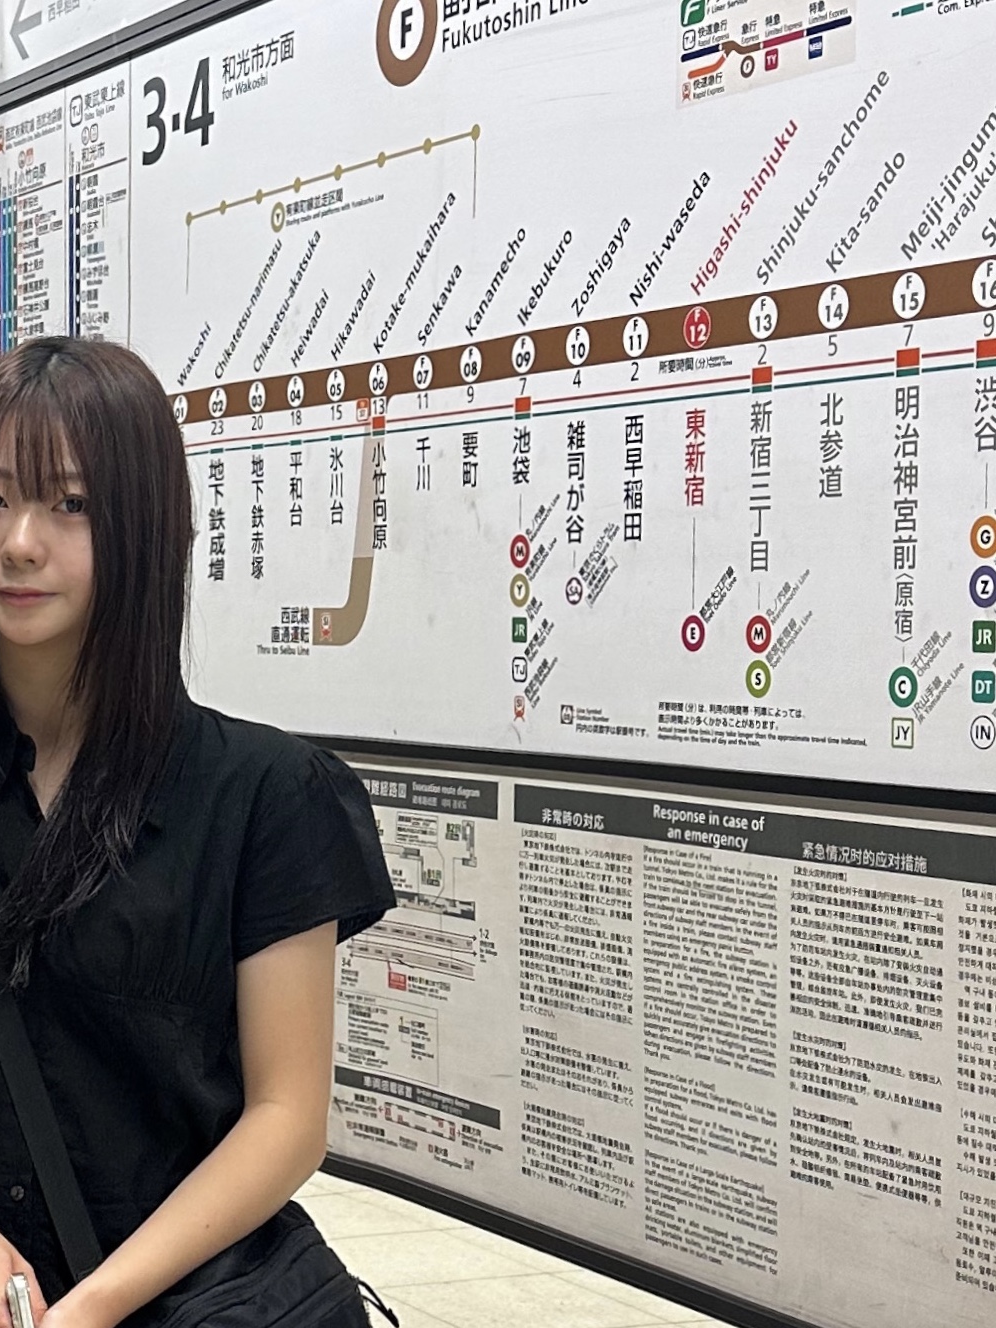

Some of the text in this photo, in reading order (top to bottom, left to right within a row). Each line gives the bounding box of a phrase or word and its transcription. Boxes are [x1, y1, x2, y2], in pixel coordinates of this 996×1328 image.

[937, 3, 961, 15] Com.
[400, 7, 414, 49] F
[441, 0, 542, 53] Fukutoshin
[741, 20, 758, 36] 急行
[221, 30, 295, 85] 和光市方面
[766, 54, 777, 66] TY
[221, 71, 269, 101] for Wakoshi
[756, 70, 890, 286] Shinjuku-sanchome
[689, 118, 799, 297] Higashi-shinjuku
[824, 151, 906, 275] Kita-sando
[628, 171, 711, 308] Nishi-waseda
[372, 191, 456, 355] Kotake-mukaihara
[570, 216, 632, 319] Zoshigaya
[986, 262, 994, 277] F
[464, 227, 526, 338] Kanamecho
[516, 229, 573, 328] Ikebukuro
[905, 275, 912, 290] F
[253, 230, 322, 374] Chikatetsu-akatsuka
[830, 287, 837, 301] F
[900, 292, 920, 312] 15
[214, 238, 283, 380] Chikatetsu-narimasu
[416, 264, 463, 348] Senkawa
[760, 299, 767, 311] F
[825, 303, 843, 321] 14
[330, 269, 377, 363] Hikawadai
[694, 309, 701, 322] F
[755, 315, 772, 333] 13
[290, 288, 330, 368] Heiwadai
[633, 320, 639, 332] F
[689, 326, 706, 342] 12
[983, 313, 995, 337] 9
[520, 338, 526, 349] F
[575, 329, 580, 341] F
[629, 334, 643, 350] 11
[902, 324, 914, 347] 7
[176, 321, 212, 387] Wakoshi
[468, 348, 473, 359] F
[571, 343, 586, 359] 10
[828, 334, 838, 357] 5
[420, 358, 425, 368] F
[515, 352, 531, 368] 09
[757, 344, 767, 366] 2
[376, 365, 380, 375] F
[464, 361, 478, 377] 08
[630, 362, 639, 382] 2
[372, 378, 385, 391] 06
[417, 372, 429, 385] 07
[519, 377, 528, 396] 7
[572, 370, 581, 388] 4
[290, 390, 301, 403] 04
[329, 383, 342, 397] 05
[466, 386, 475, 403] 9
[211, 400, 223, 413] 02
[251, 394, 262, 407] 03
[372, 399, 385, 415] 13
[417, 393, 429, 409] 11
[290, 410, 303, 426] 18
[330, 405, 343, 421] 15
[973, 376, 996, 454] 渋谷
[210, 421, 224, 436] 23
[251, 416, 263, 431] 20
[817, 393, 844, 499] 北参道
[415, 436, 432, 492] 千川
[462, 432, 479, 488] 要町
[512, 426, 531, 486] 池袋
[684, 407, 706, 508] 東新宿
[329, 446, 344, 526] 氷川台
[565, 420, 586, 545] 雑司が谷
[622, 413, 645, 543] 西早稲田
[749, 400, 773, 573] 新宿三丁目
[289, 451, 303, 527] 平和台
[371, 442, 388, 550] 小竹向原
[207, 459, 226, 582] 地下鉄成増
[250, 454, 264, 580] 地下鉄赤塚
[980, 529, 991, 545] G
[515, 546, 525, 557] M
[799, 569, 810, 586] Line
[516, 584, 523, 596] Y
[980, 580, 990, 595] Z
[281, 606, 310, 624] 西武線
[801, 610, 813, 627] Line
[271, 626, 310, 643] 直通運転
[514, 624, 525, 637] JR
[690, 627, 696, 640] E
[753, 627, 764, 640] M
[938, 630, 953, 648] Line
[975, 629, 993, 645] JR
[279, 645, 296, 656] Seibu
[297, 645, 310, 656] Line
[910, 630, 941, 670] 千代田線
[514, 664, 525, 675] TJ
[950, 661, 965, 681] Line
[754, 672, 762, 686] S
[898, 680, 906, 695] C
[975, 680, 993, 695] DT
[911, 675, 943, 718] JR山手線
[895, 725, 911, 740] JY
[975, 725, 991, 740] IN
[541, 807, 605, 831] 非常時の対応
[653, 804, 765, 832] Response in case of
[667, 827, 748, 852] an emergency
[802, 841, 928, 874] 紧急情况时的应对措施
